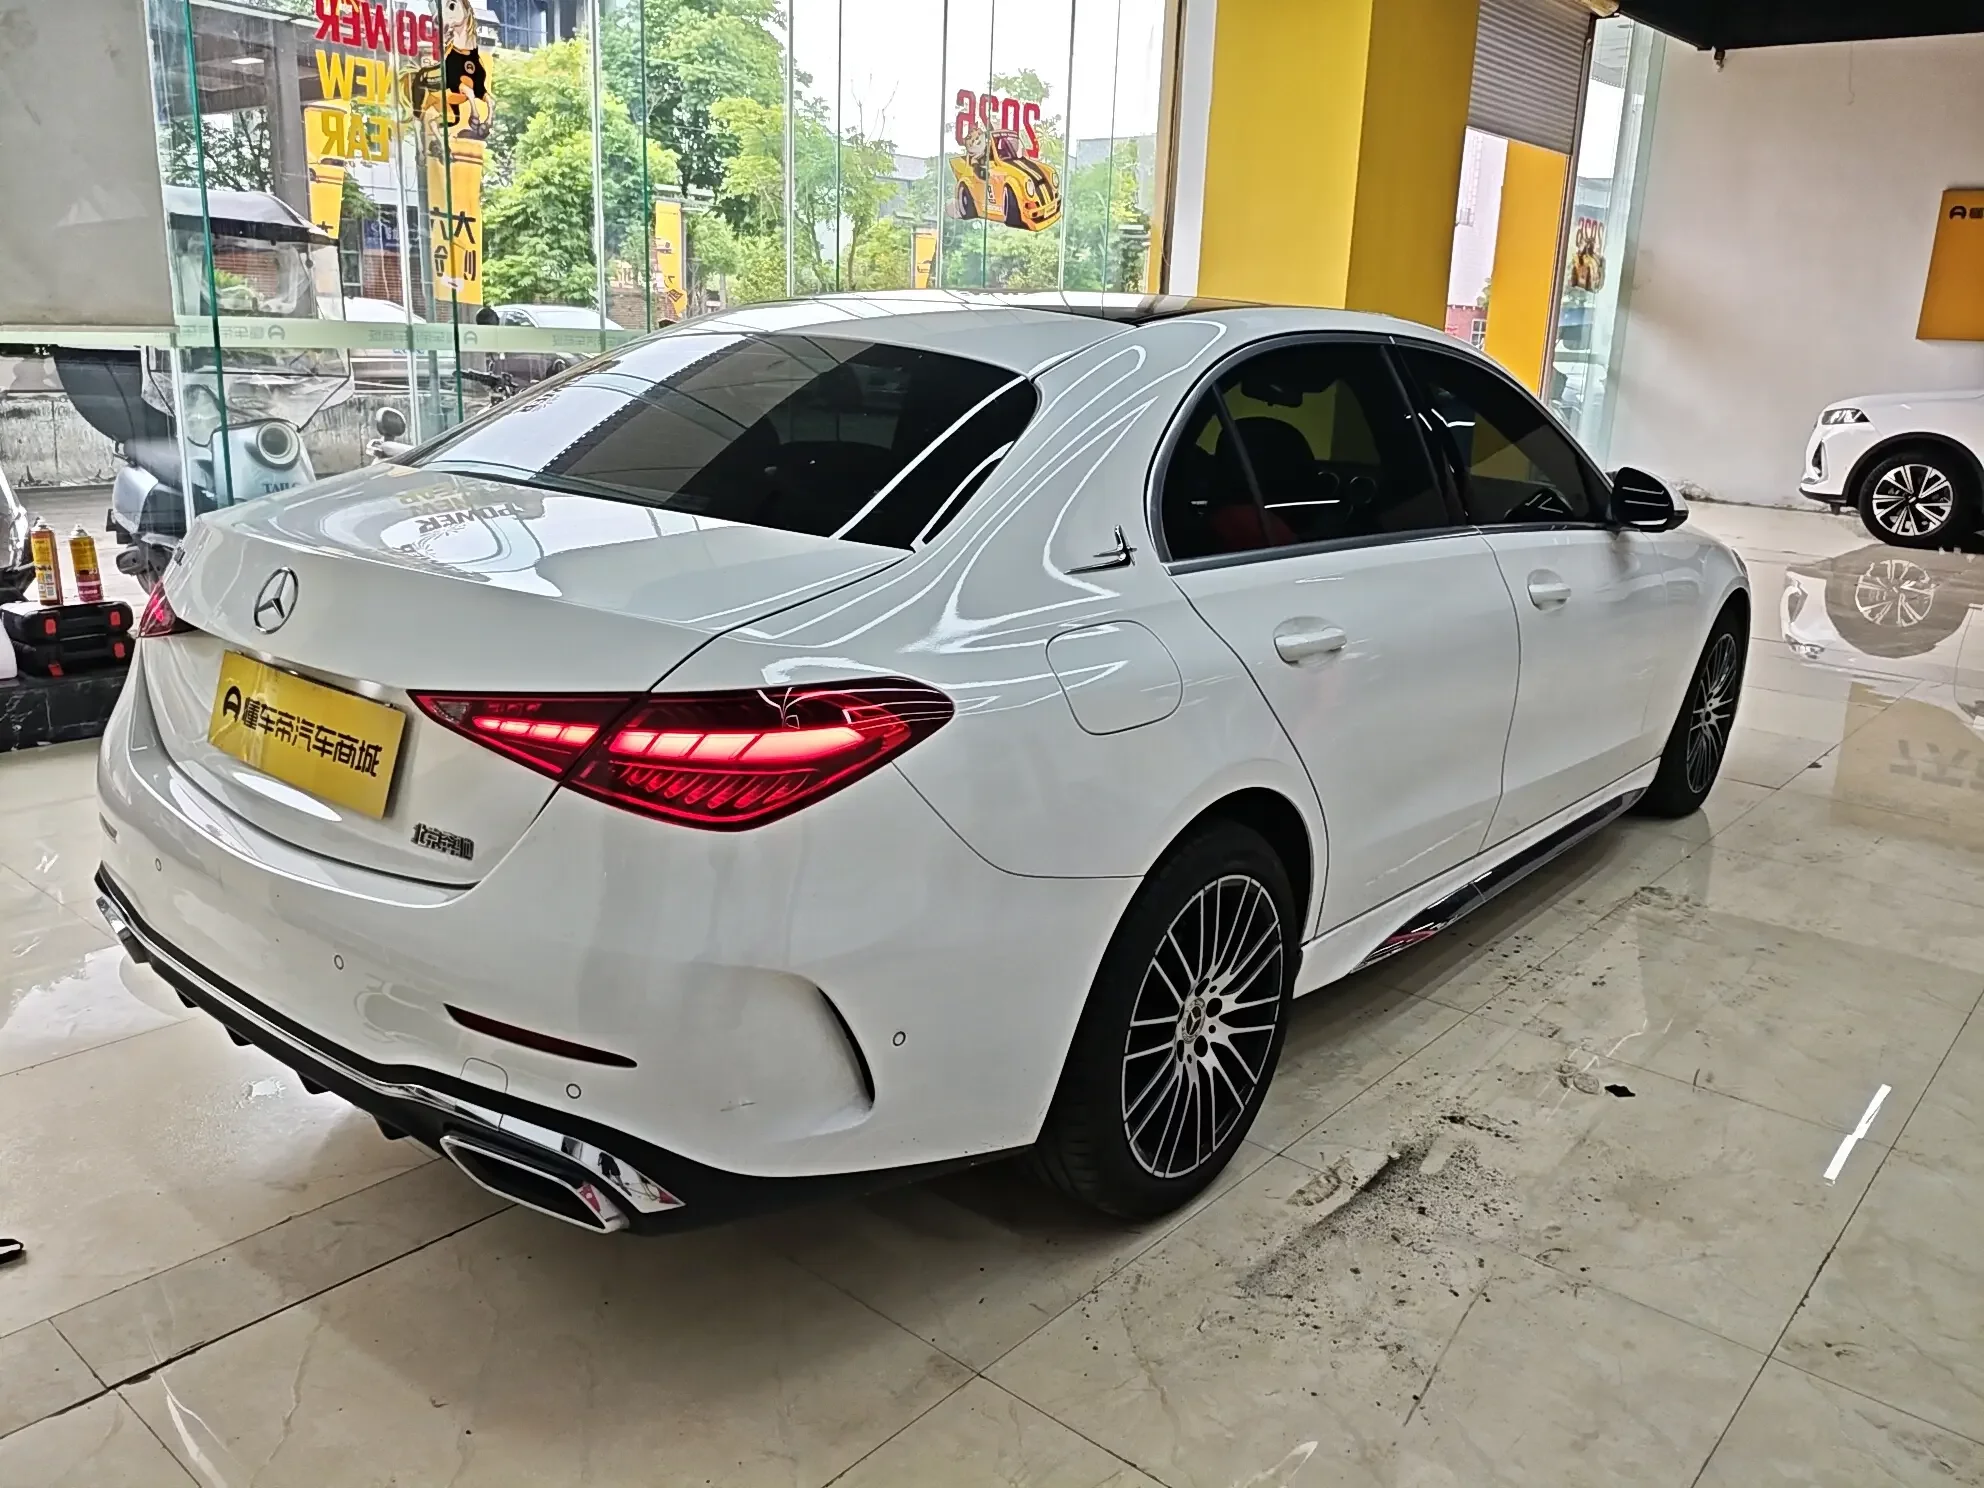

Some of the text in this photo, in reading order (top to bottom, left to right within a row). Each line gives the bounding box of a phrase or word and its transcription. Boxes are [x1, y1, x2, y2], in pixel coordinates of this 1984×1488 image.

[242, 696, 383, 778] 懂车帝汽车商城
